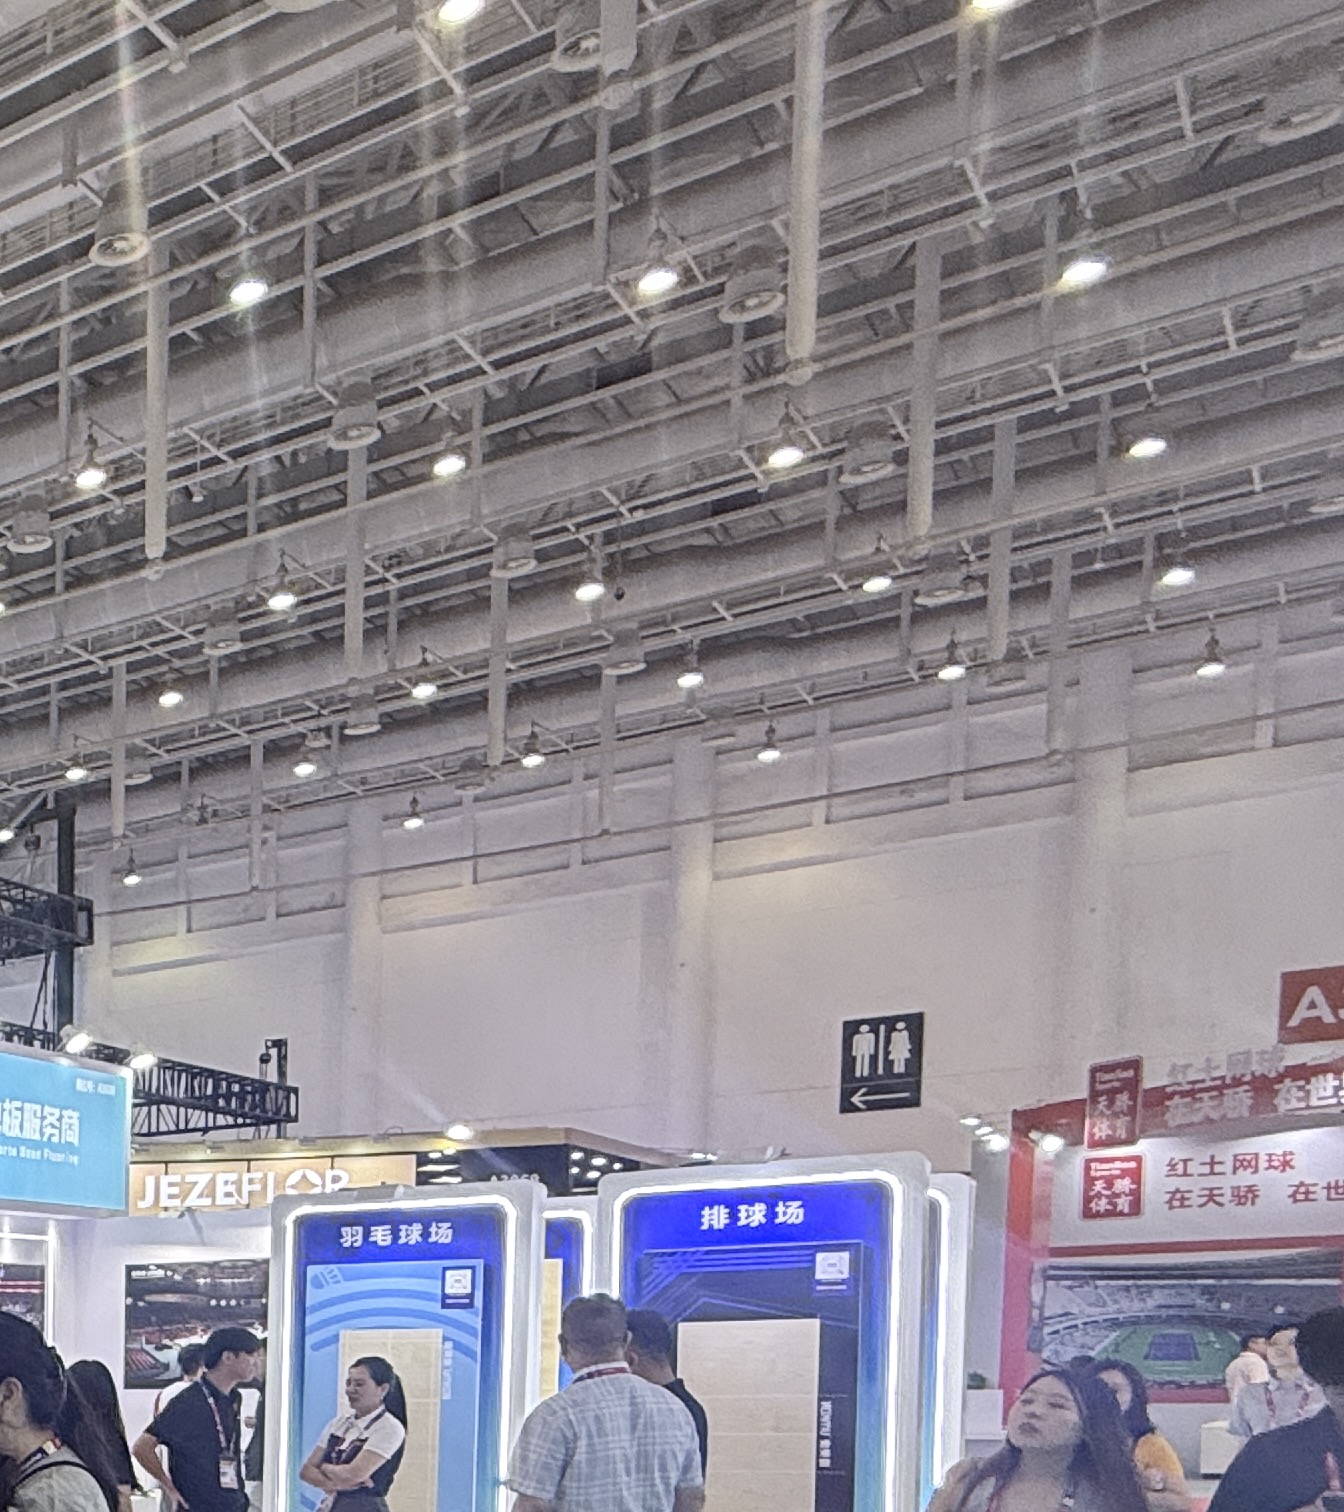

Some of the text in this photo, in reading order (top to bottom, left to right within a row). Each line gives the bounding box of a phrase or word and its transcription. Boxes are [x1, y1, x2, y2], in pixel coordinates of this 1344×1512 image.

[1286, 985, 1344, 1028] A
[1273, 1072, 1344, 1113] 在世
[1164, 1150, 1296, 1178] 红土网球
[1164, 1183, 1261, 1211] 在天骄
[699, 1200, 805, 1231] 排球场
[339, 1221, 454, 1248] 羽毛球场
